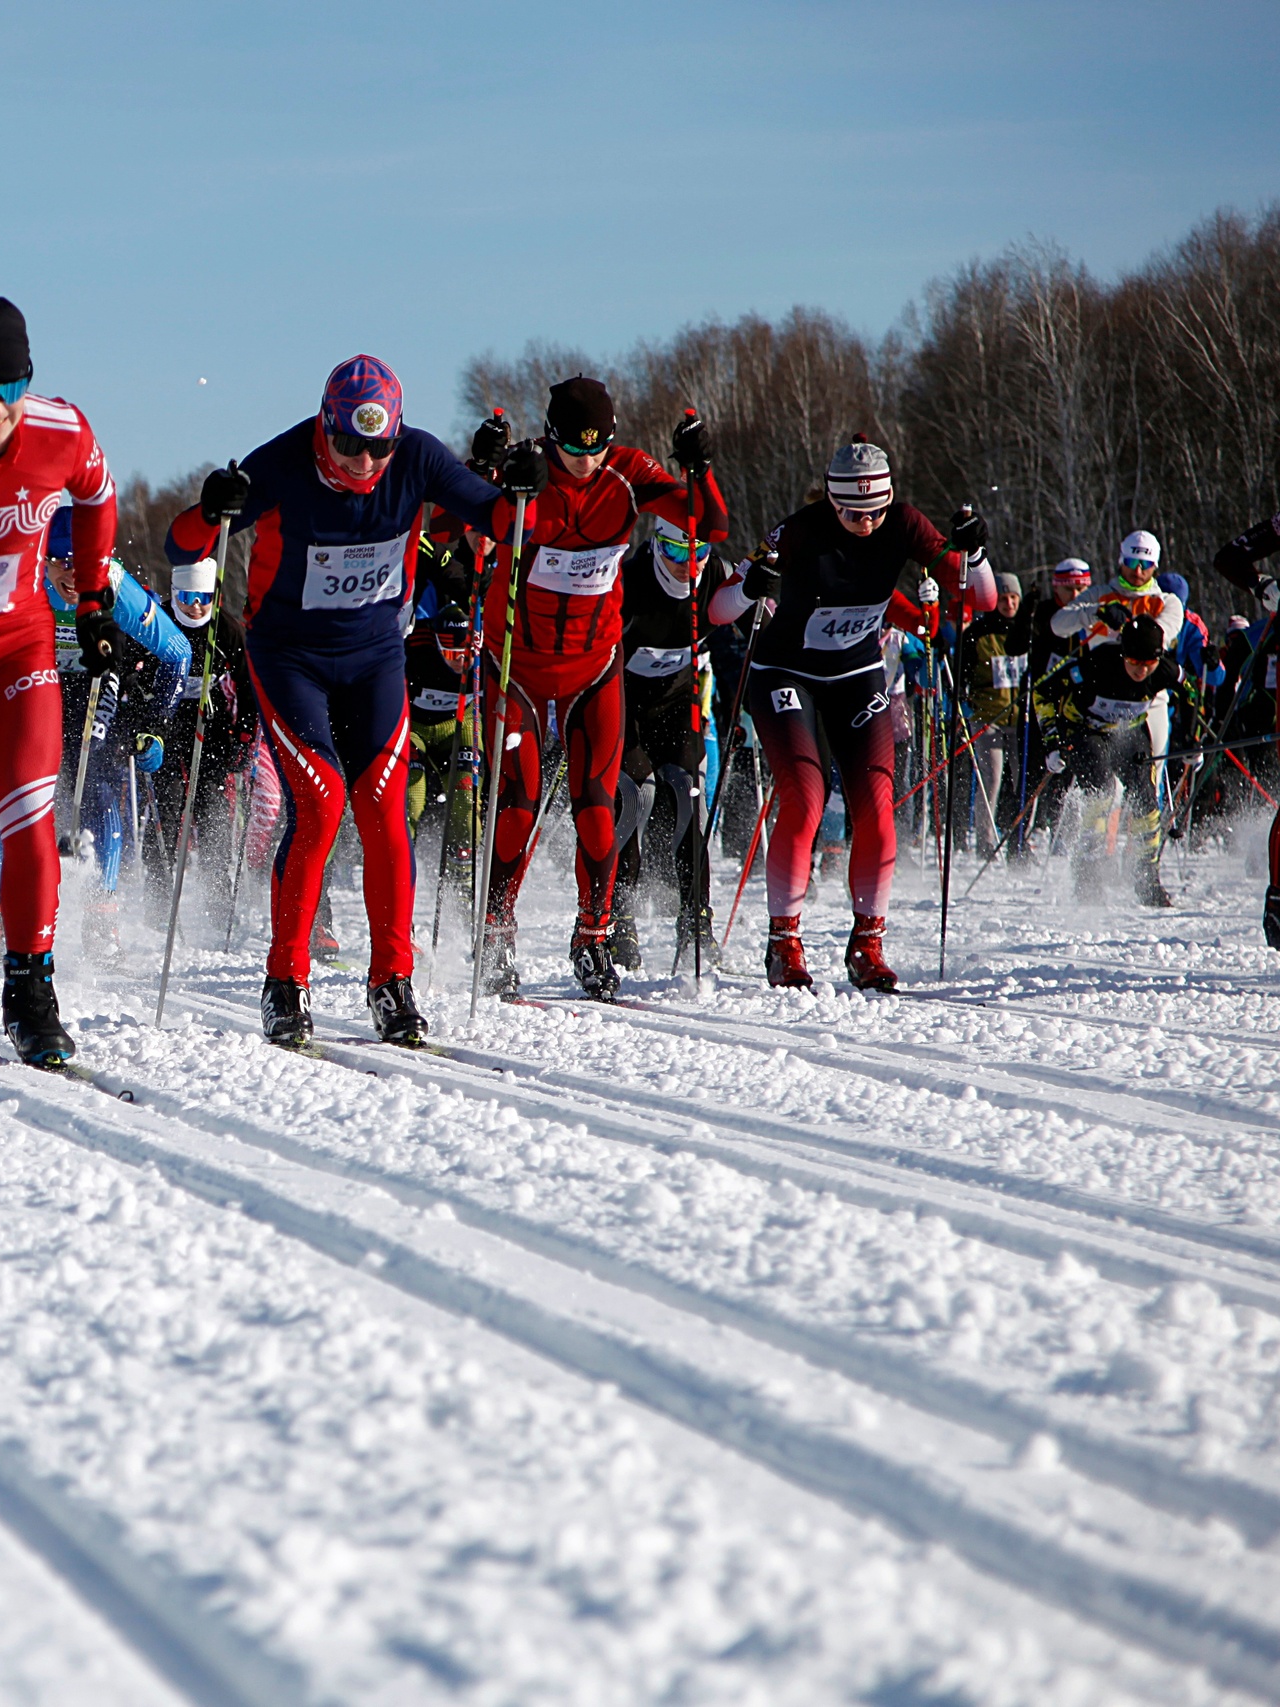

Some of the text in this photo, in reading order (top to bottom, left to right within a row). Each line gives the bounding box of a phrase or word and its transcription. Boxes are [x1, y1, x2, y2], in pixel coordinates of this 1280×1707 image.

[343, 546, 375, 554] ЛЫЖНЯ
[343, 552, 376, 560] РОССИИ
[343, 559, 376, 569] 2024
[322, 563, 390, 596] 3056
[821, 615, 880, 638] 4482
[4, 669, 60, 701] BOSCO
